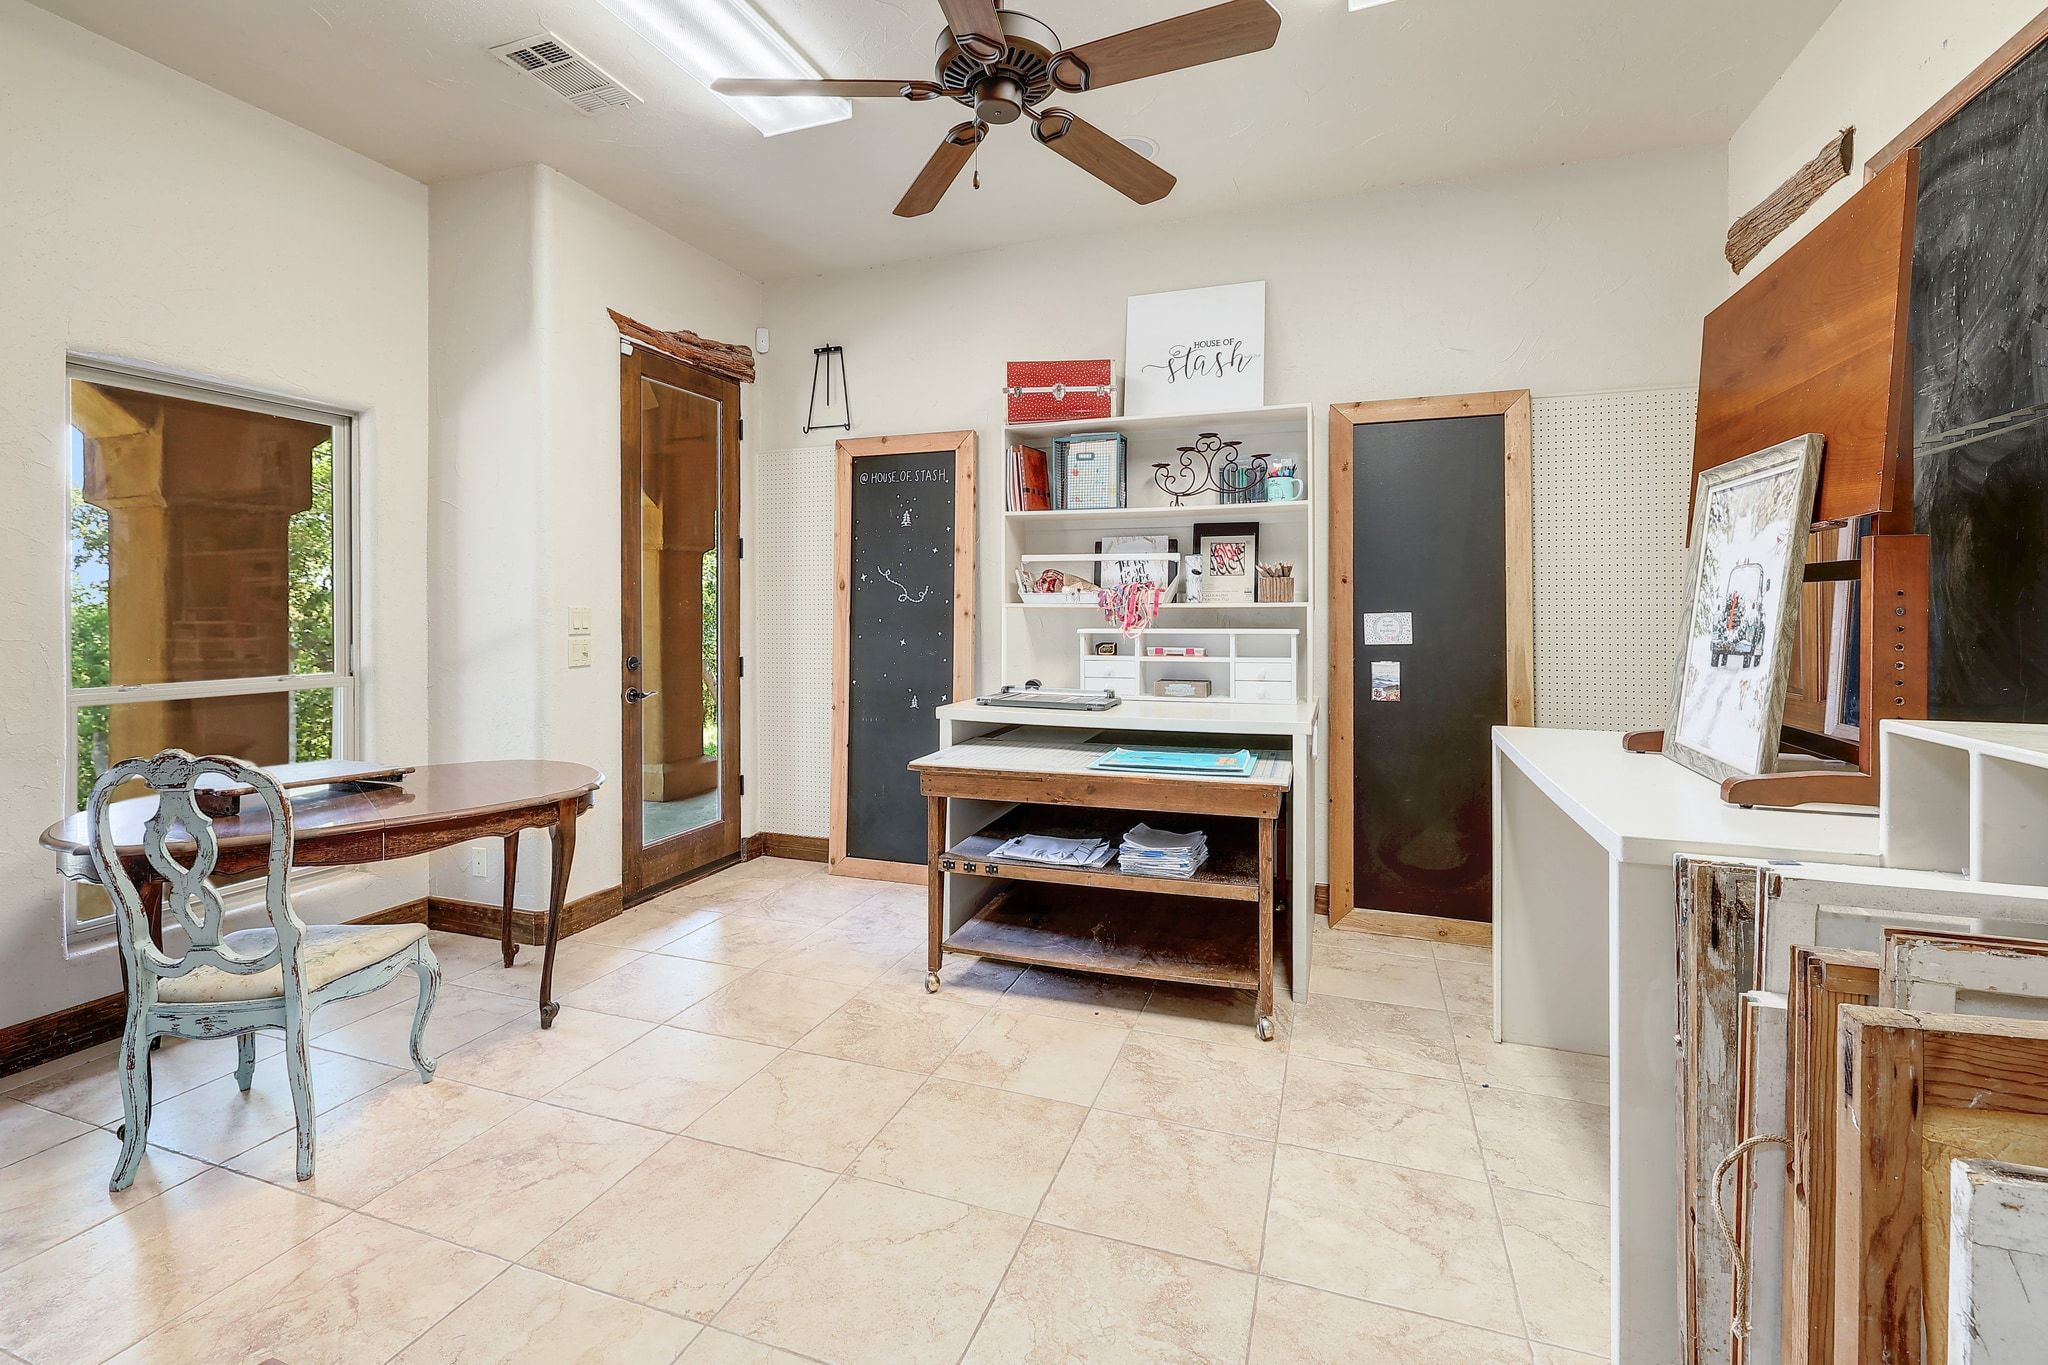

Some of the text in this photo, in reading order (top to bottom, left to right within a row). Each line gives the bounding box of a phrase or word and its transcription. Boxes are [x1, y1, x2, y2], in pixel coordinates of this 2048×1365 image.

[1193, 338, 1235, 349] HOUSE OF
[1142, 341, 1253, 383] stash
